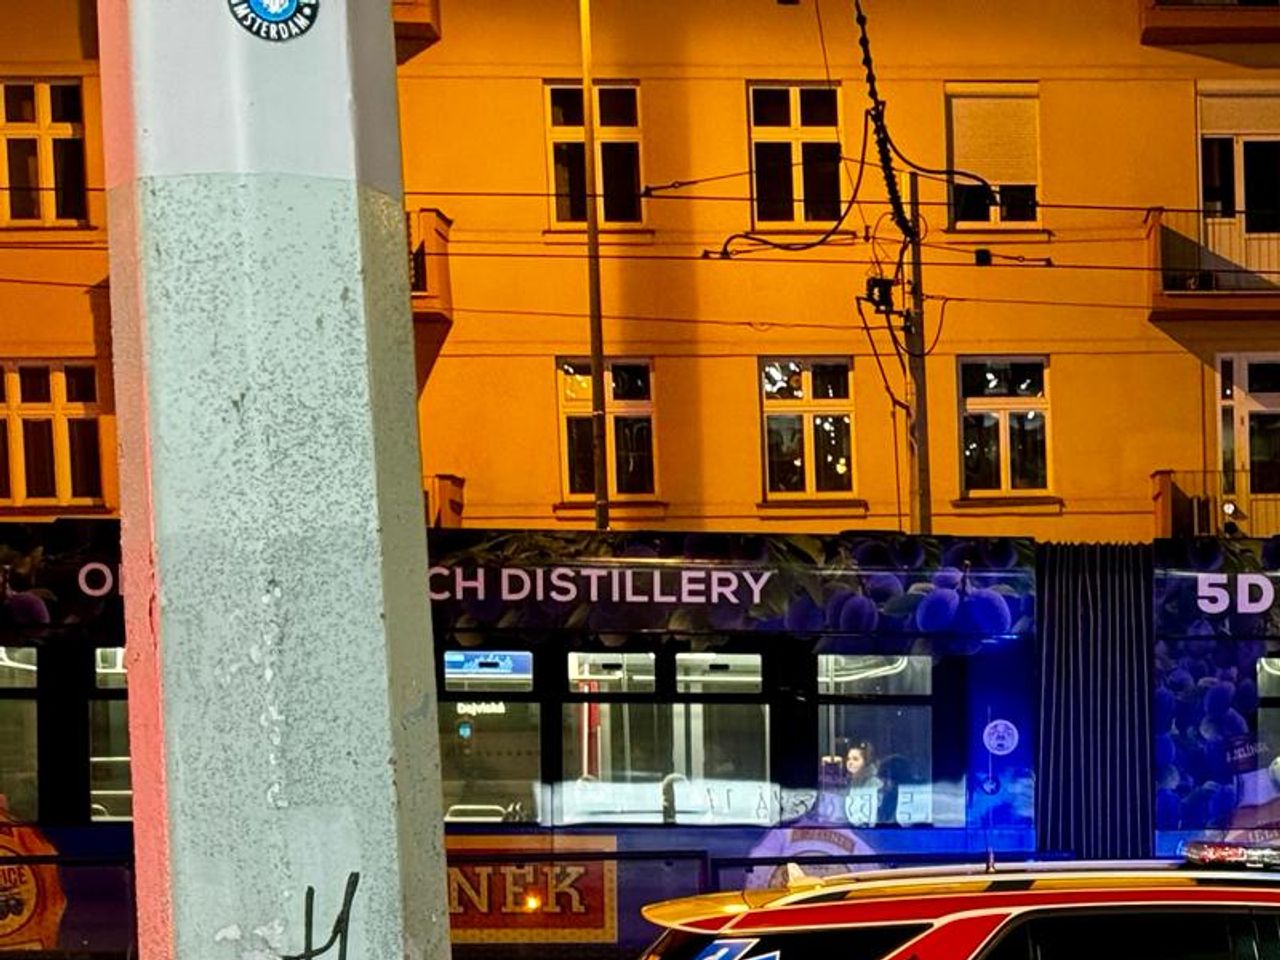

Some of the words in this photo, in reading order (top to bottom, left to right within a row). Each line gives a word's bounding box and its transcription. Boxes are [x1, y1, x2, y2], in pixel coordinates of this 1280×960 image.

[231, 0, 311, 39] MSTERDAM
[428, 566, 486, 601] CH
[501, 568, 772, 604] DISTILLERY
[1196, 573, 1275, 614] 5D
